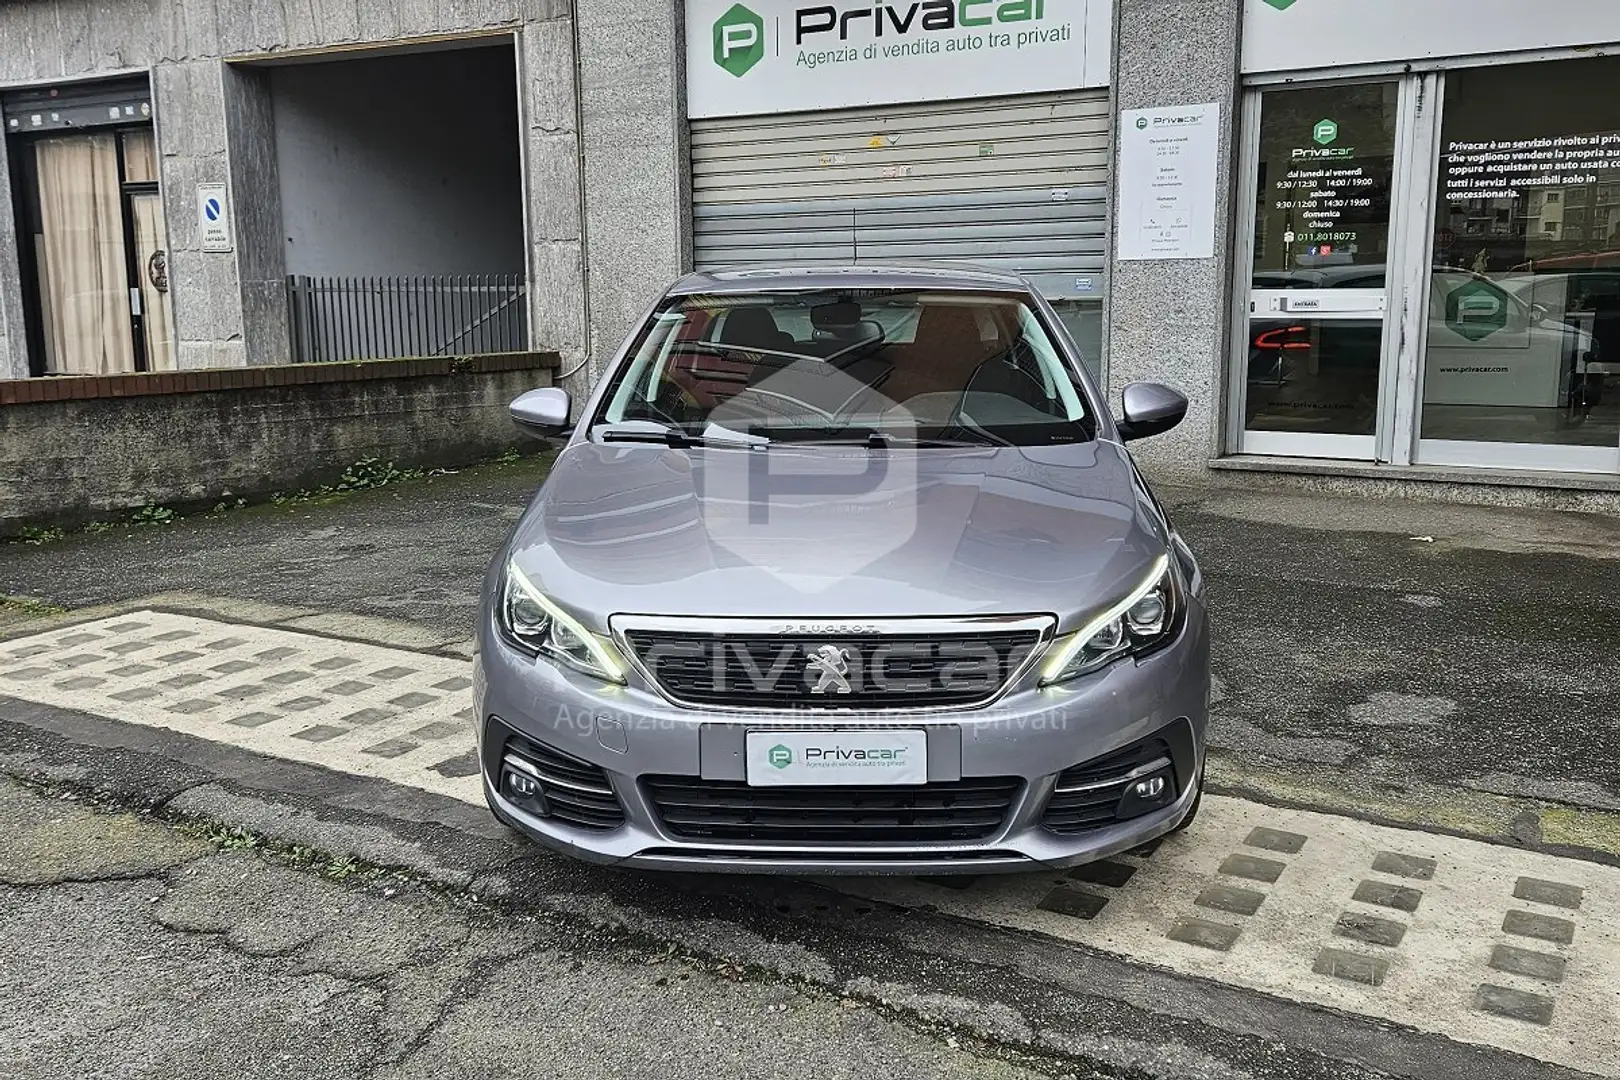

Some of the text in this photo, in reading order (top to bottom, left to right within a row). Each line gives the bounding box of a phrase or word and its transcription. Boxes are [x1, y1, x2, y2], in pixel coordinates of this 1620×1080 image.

[796, 23, 1071, 69] Agenzia di vendita auto tra privati
[1153, 115, 1203, 124] Privacar
[1449, 141, 1489, 151] Privacar
[1490, 140, 1497, 149] è
[1512, 138, 1552, 149] servizio
[1553, 135, 1588, 146] rivolto
[1589, 134, 1600, 144] ai
[1292, 147, 1355, 157] Privacar
[1448, 153, 1465, 163] che
[1467, 152, 1510, 164] vogliono
[1512, 149, 1553, 160] vendere
[1554, 148, 1564, 158] la
[1565, 147, 1605, 160] propria
[1448, 165, 1484, 175] oppure
[1486, 162, 1538, 174] acquistare
[1554, 161, 1579, 169] auto
[1580, 159, 1609, 169] usata
[1286, 170, 1299, 178] dal
[1325, 168, 1332, 176] al
[1298, 180, 1317, 188] 12:30
[1352, 178, 1373, 186] 19:00
[1447, 178, 1469, 187] tutti
[1474, 177, 1507, 187] servizi
[1510, 174, 1561, 186] accessibili
[1562, 174, 1584, 184] solo
[1586, 173, 1597, 183] in
[1310, 189, 1337, 197] sabato
[1445, 189, 1520, 200] concessionaria.
[1276, 201, 1292, 209] 9:30
[1298, 200, 1317, 208] 12:00
[1324, 199, 1344, 207] 14:30
[1350, 198, 1370, 206] 19:00
[1303, 210, 1340, 218] domenica
[1309, 220, 1334, 228] chiuso
[1297, 232, 1356, 241] 011.8018073
[785, 624, 875, 633] PEUGEOT
[805, 746, 906, 760] Privacar
